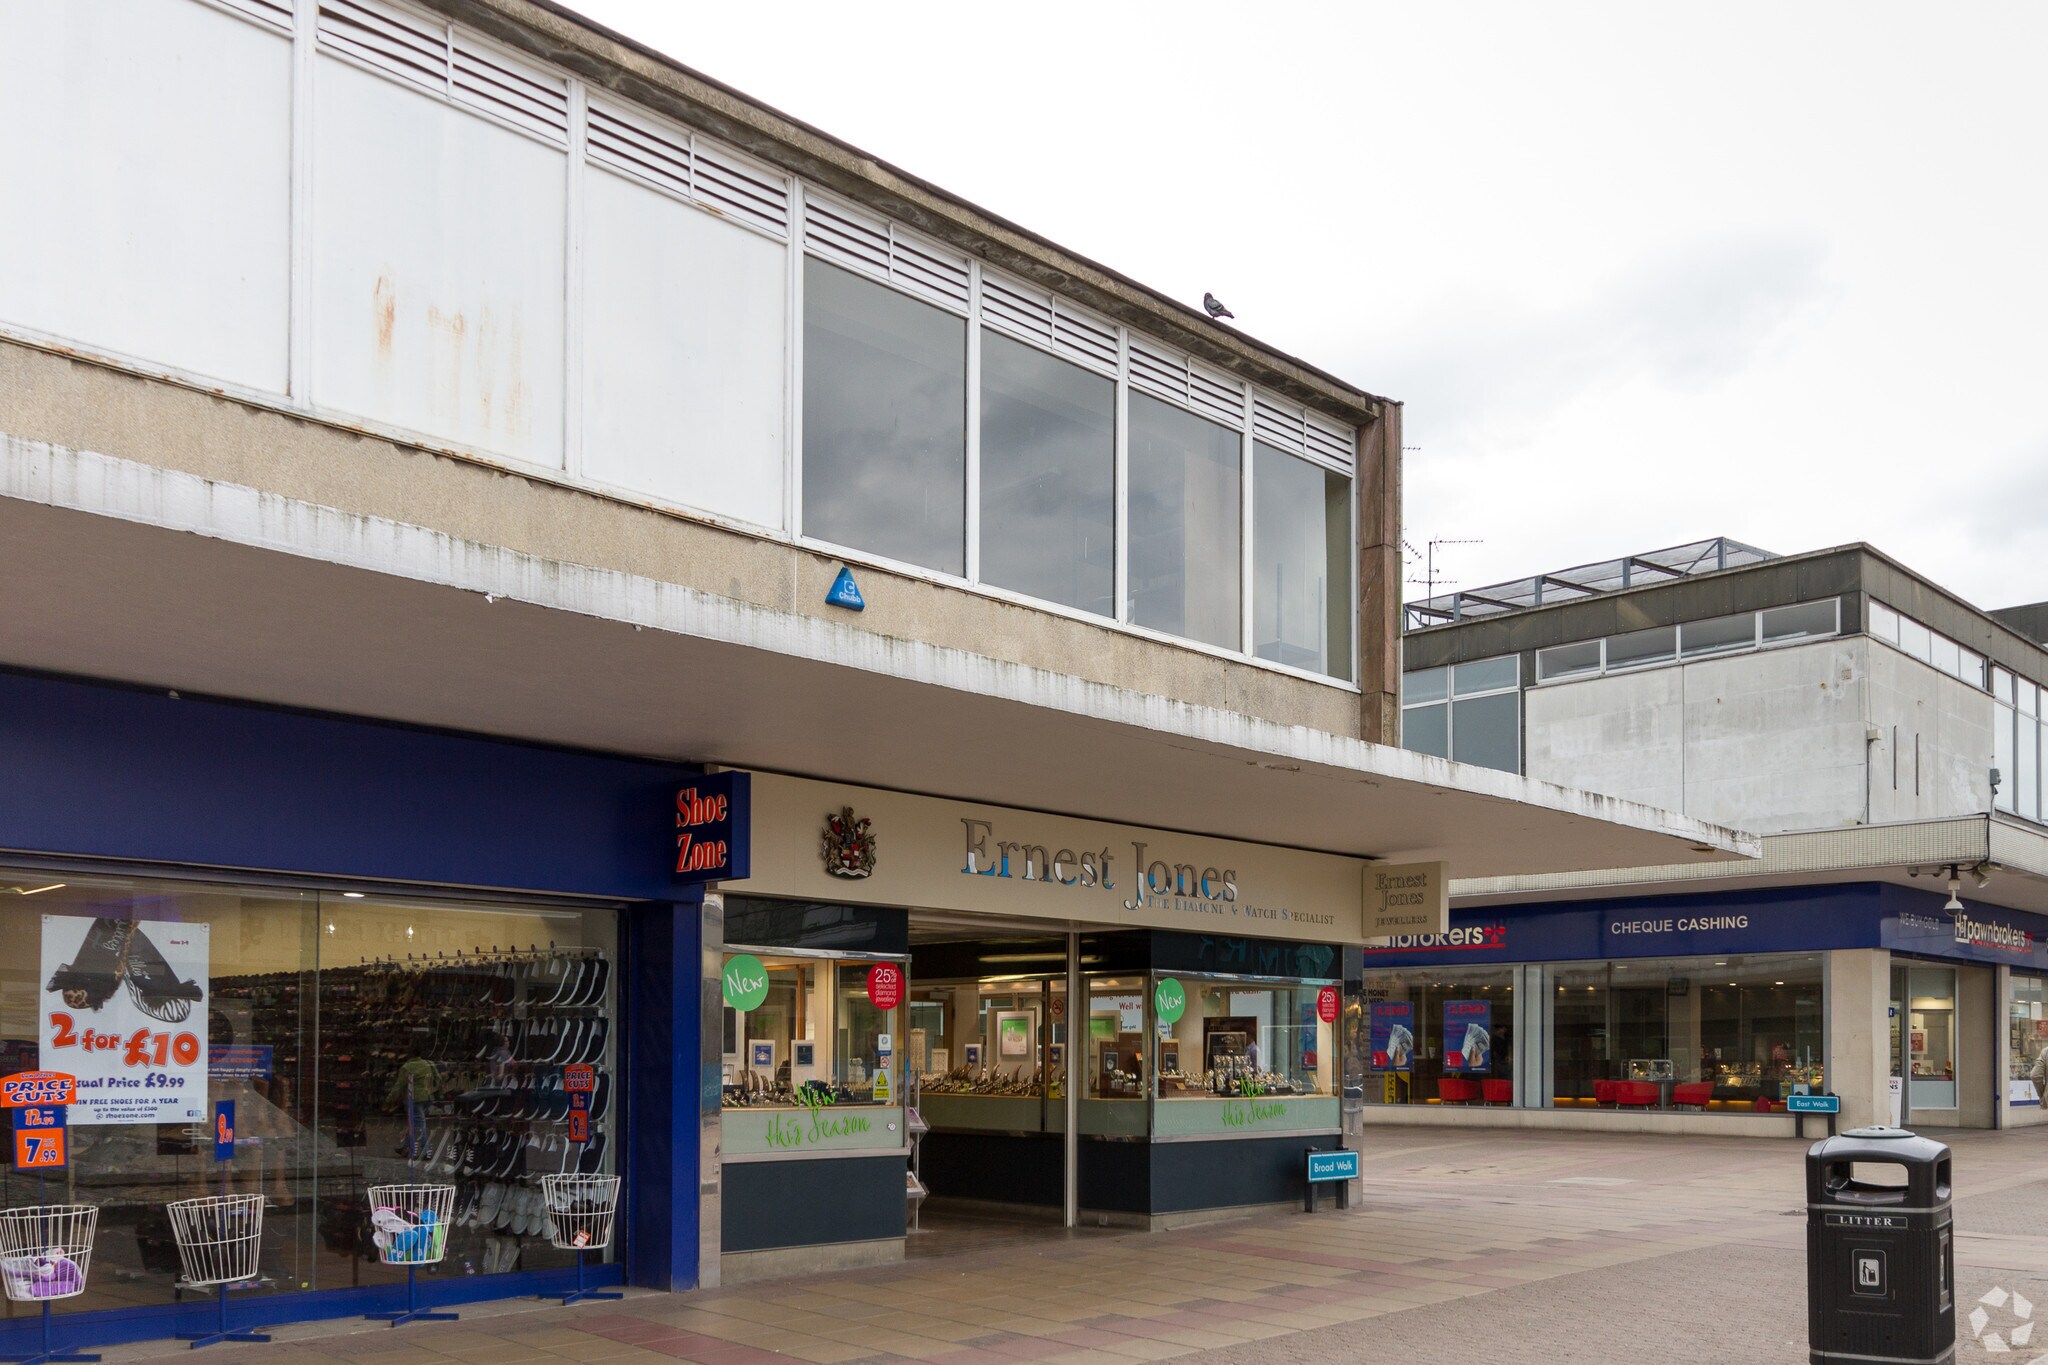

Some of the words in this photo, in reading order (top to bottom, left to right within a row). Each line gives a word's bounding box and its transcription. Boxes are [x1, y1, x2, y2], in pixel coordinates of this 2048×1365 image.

[839, 592, 861, 602] Chubb
[676, 787, 728, 828] Shoe
[676, 833, 727, 872] Zone
[961, 818, 1116, 890] Ernest
[1124, 842, 1239, 910] Jones
[1375, 873, 1427, 890] Ernest
[1378, 890, 1424, 912] Jones
[1375, 916, 1428, 928] JEWELLERS
[1611, 920, 1673, 934] CHEQUE
[1677, 915, 1749, 931] CASHING
[1899, 911, 1910, 926] WE
[1967, 920, 2026, 948] pawnbrokers
[726, 968, 764, 997] New
[875, 968, 897, 983] 25%
[1119, 1002, 1133, 1010] Well
[1158, 989, 1183, 1012] New
[49, 1011, 79, 1049] 2
[80, 1028, 122, 1053] for
[123, 1027, 200, 1068] £10
[76, 1078, 103, 1088] sual
[108, 1078, 140, 1088] Price
[145, 1072, 184, 1088] £9.99
[566, 1072, 591, 1080] PRICE
[568, 1080, 589, 1088] CUTS
[4, 1079, 74, 1093] PRICE
[796, 1079, 838, 1109] New
[1240, 1076, 1265, 1097] New
[10, 1090, 68, 1103] CUTS
[25, 1109, 55, 1126] 12.99
[1222, 1101, 1245, 1127] this
[1247, 1098, 1287, 1123] Season
[765, 1112, 802, 1147] this
[808, 1108, 873, 1143] Season
[25, 1137, 57, 1163] 7.99
[1314, 1162, 1334, 1173] Broad
[1336, 1161, 1353, 1170] Walk
[1840, 1216, 1892, 1226] LITTER
